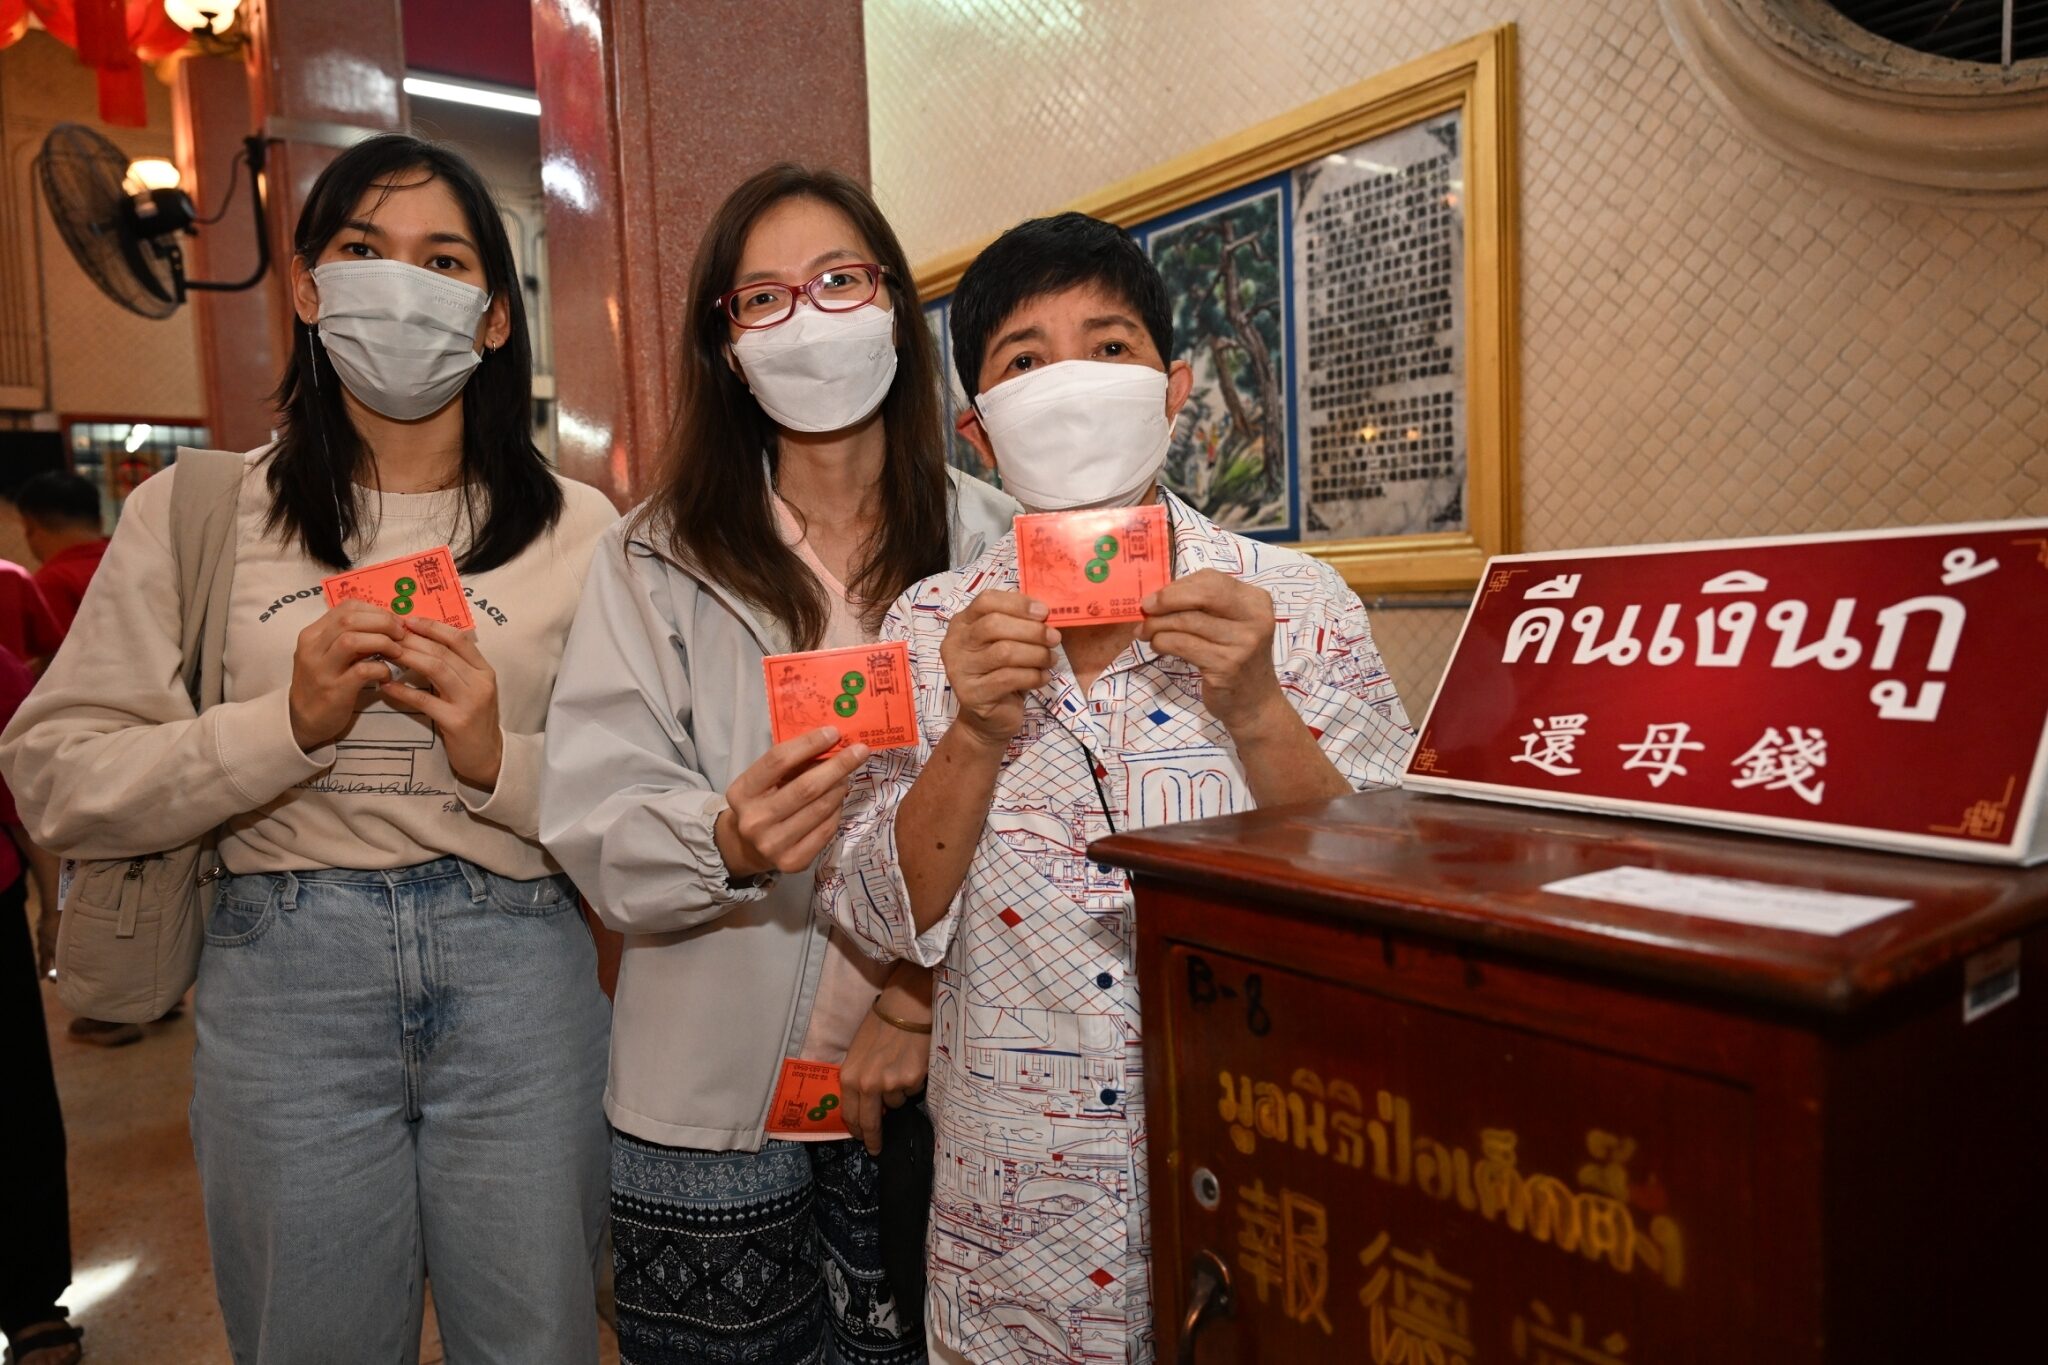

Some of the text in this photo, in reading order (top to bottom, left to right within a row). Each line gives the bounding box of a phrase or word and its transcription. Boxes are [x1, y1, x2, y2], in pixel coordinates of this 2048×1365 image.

[259, 585, 508, 626] SNOOP ACE
[1501, 547, 2000, 722] คืนเงินกู้
[1510, 713, 1829, 805] 還母錢
